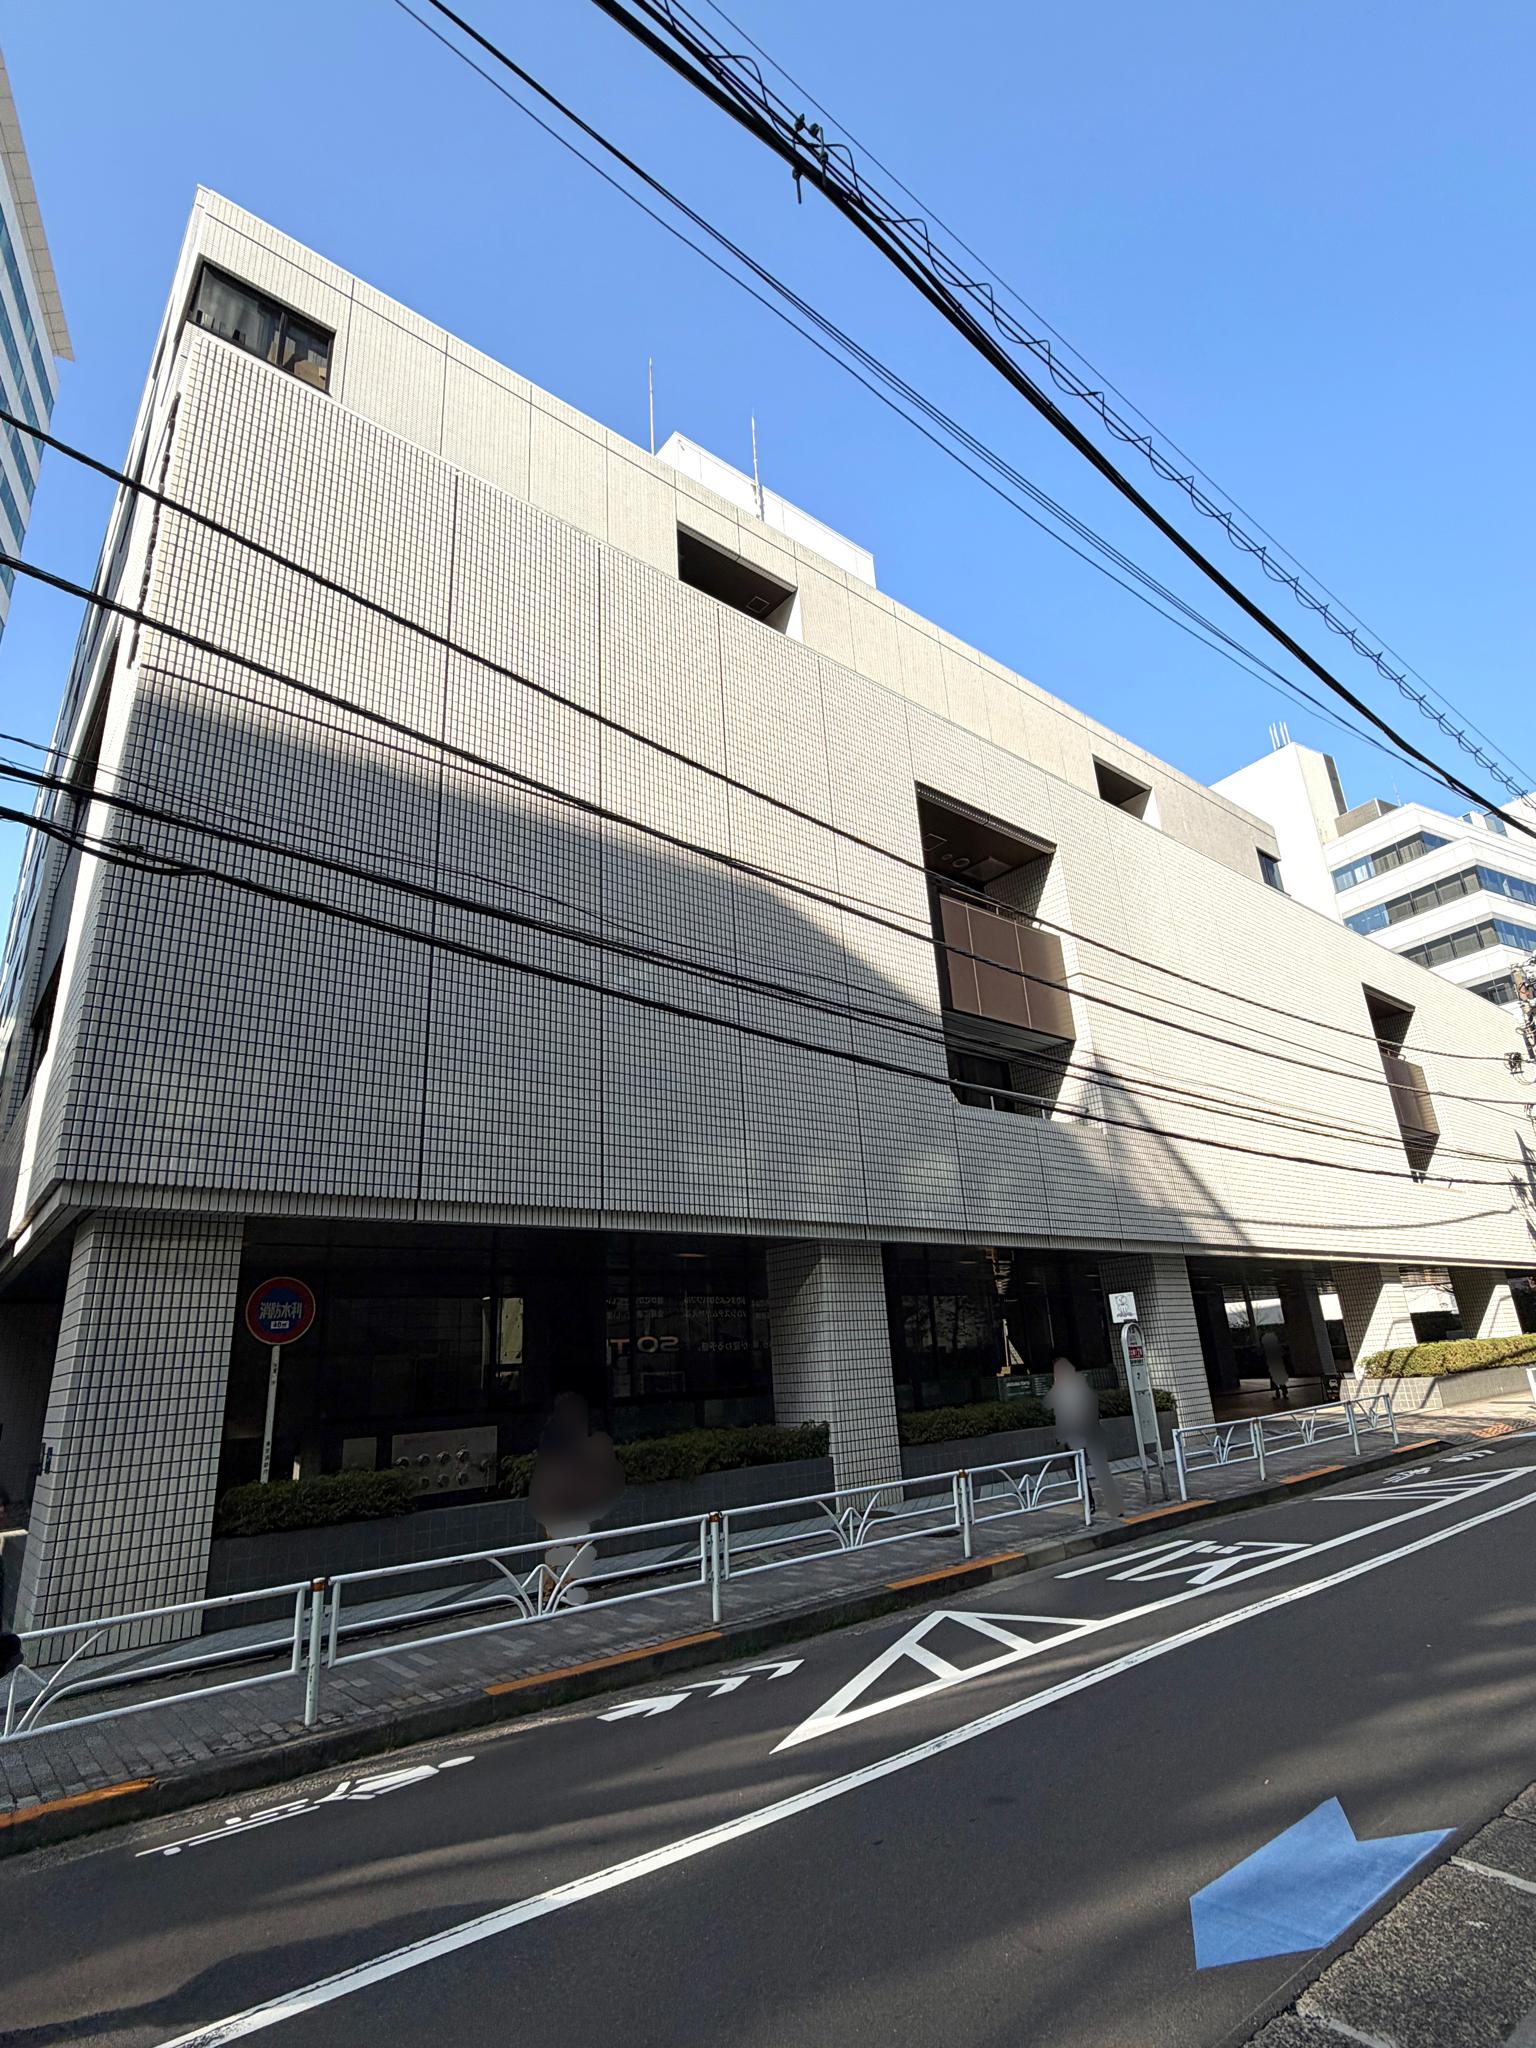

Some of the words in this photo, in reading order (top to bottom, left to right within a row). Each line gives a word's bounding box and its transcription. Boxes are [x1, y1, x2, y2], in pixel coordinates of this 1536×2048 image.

[259, 1302, 302, 1319] 消防水利
[1054, 1539, 1313, 1585] バス
